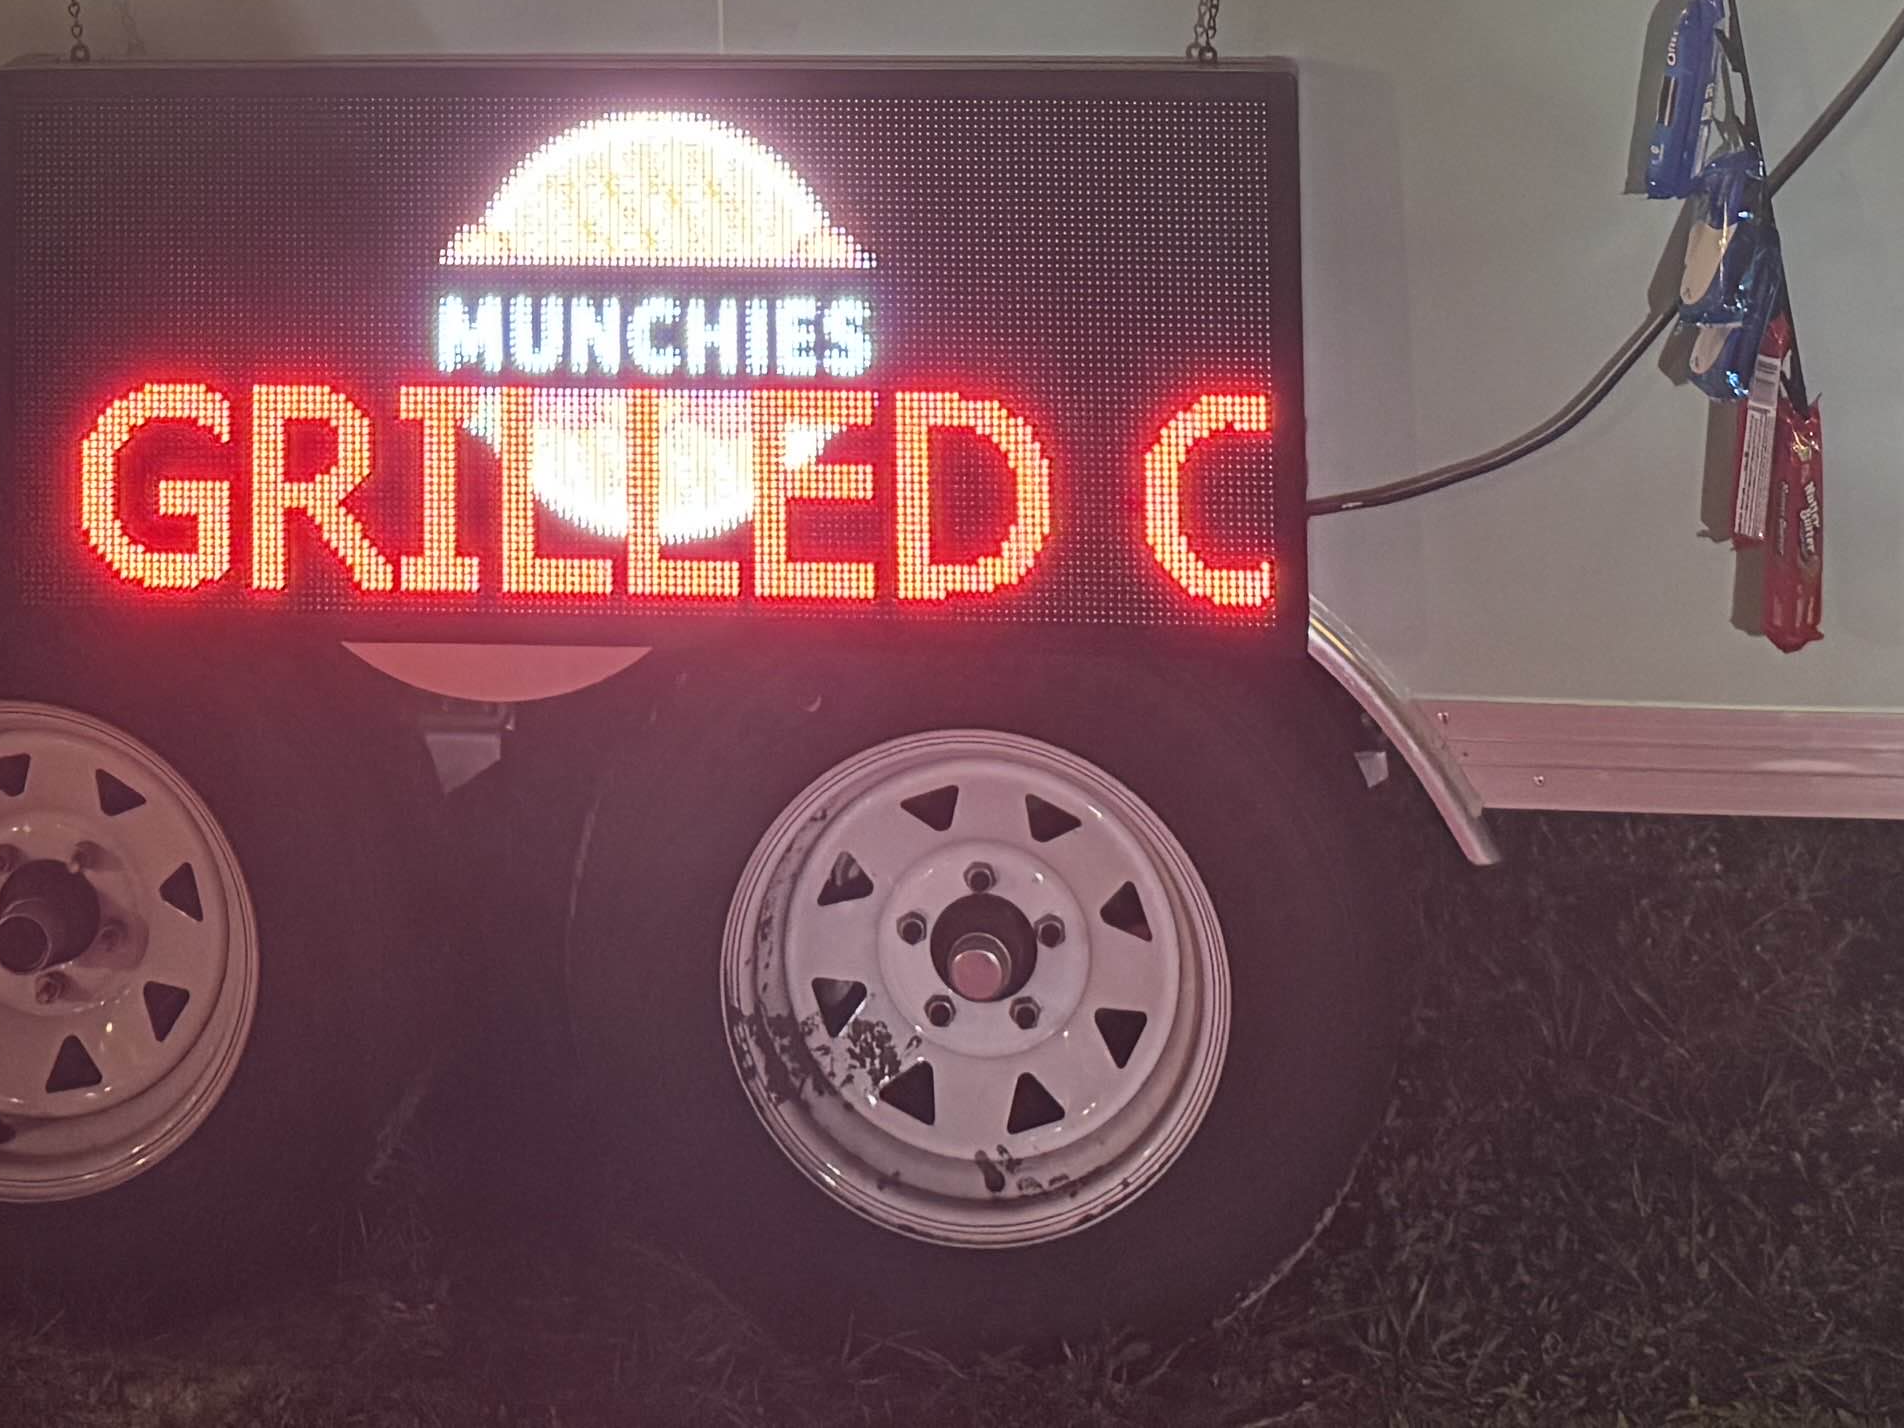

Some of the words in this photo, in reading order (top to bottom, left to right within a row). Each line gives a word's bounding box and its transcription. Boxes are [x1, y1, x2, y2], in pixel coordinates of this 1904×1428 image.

[436, 294, 876, 377] MUNCHIES
[80, 381, 1053, 601] GRILLED
[1145, 391, 1273, 609] C
